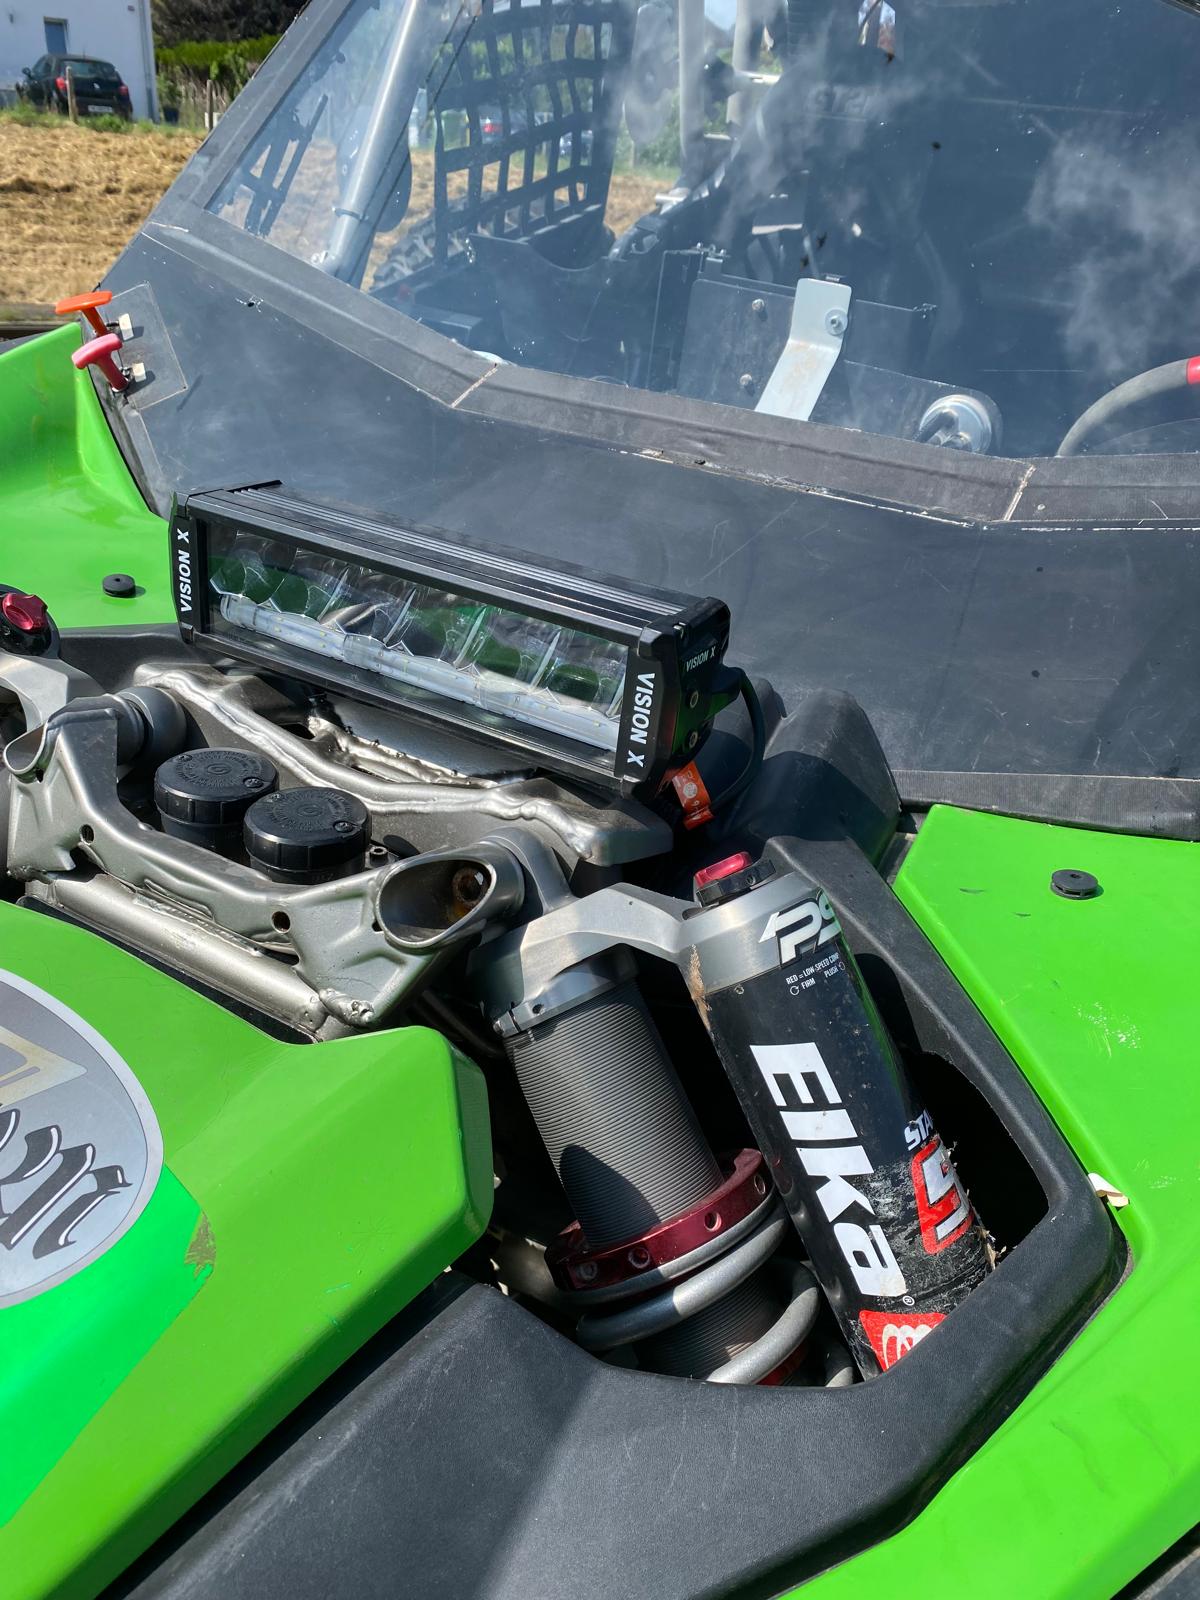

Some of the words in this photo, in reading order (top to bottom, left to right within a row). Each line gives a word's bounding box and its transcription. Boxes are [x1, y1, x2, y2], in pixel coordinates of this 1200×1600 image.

[176, 528, 190, 544] X
[178, 549, 193, 612] VISION
[686, 650, 709, 672] VISION
[710, 646, 716, 659] X
[629, 673, 656, 745] VISION
[627, 750, 645, 768] X
[785, 974, 799, 985] RED
[823, 965, 839, 978] PLUSH
[800, 977, 816, 989] FIRM
